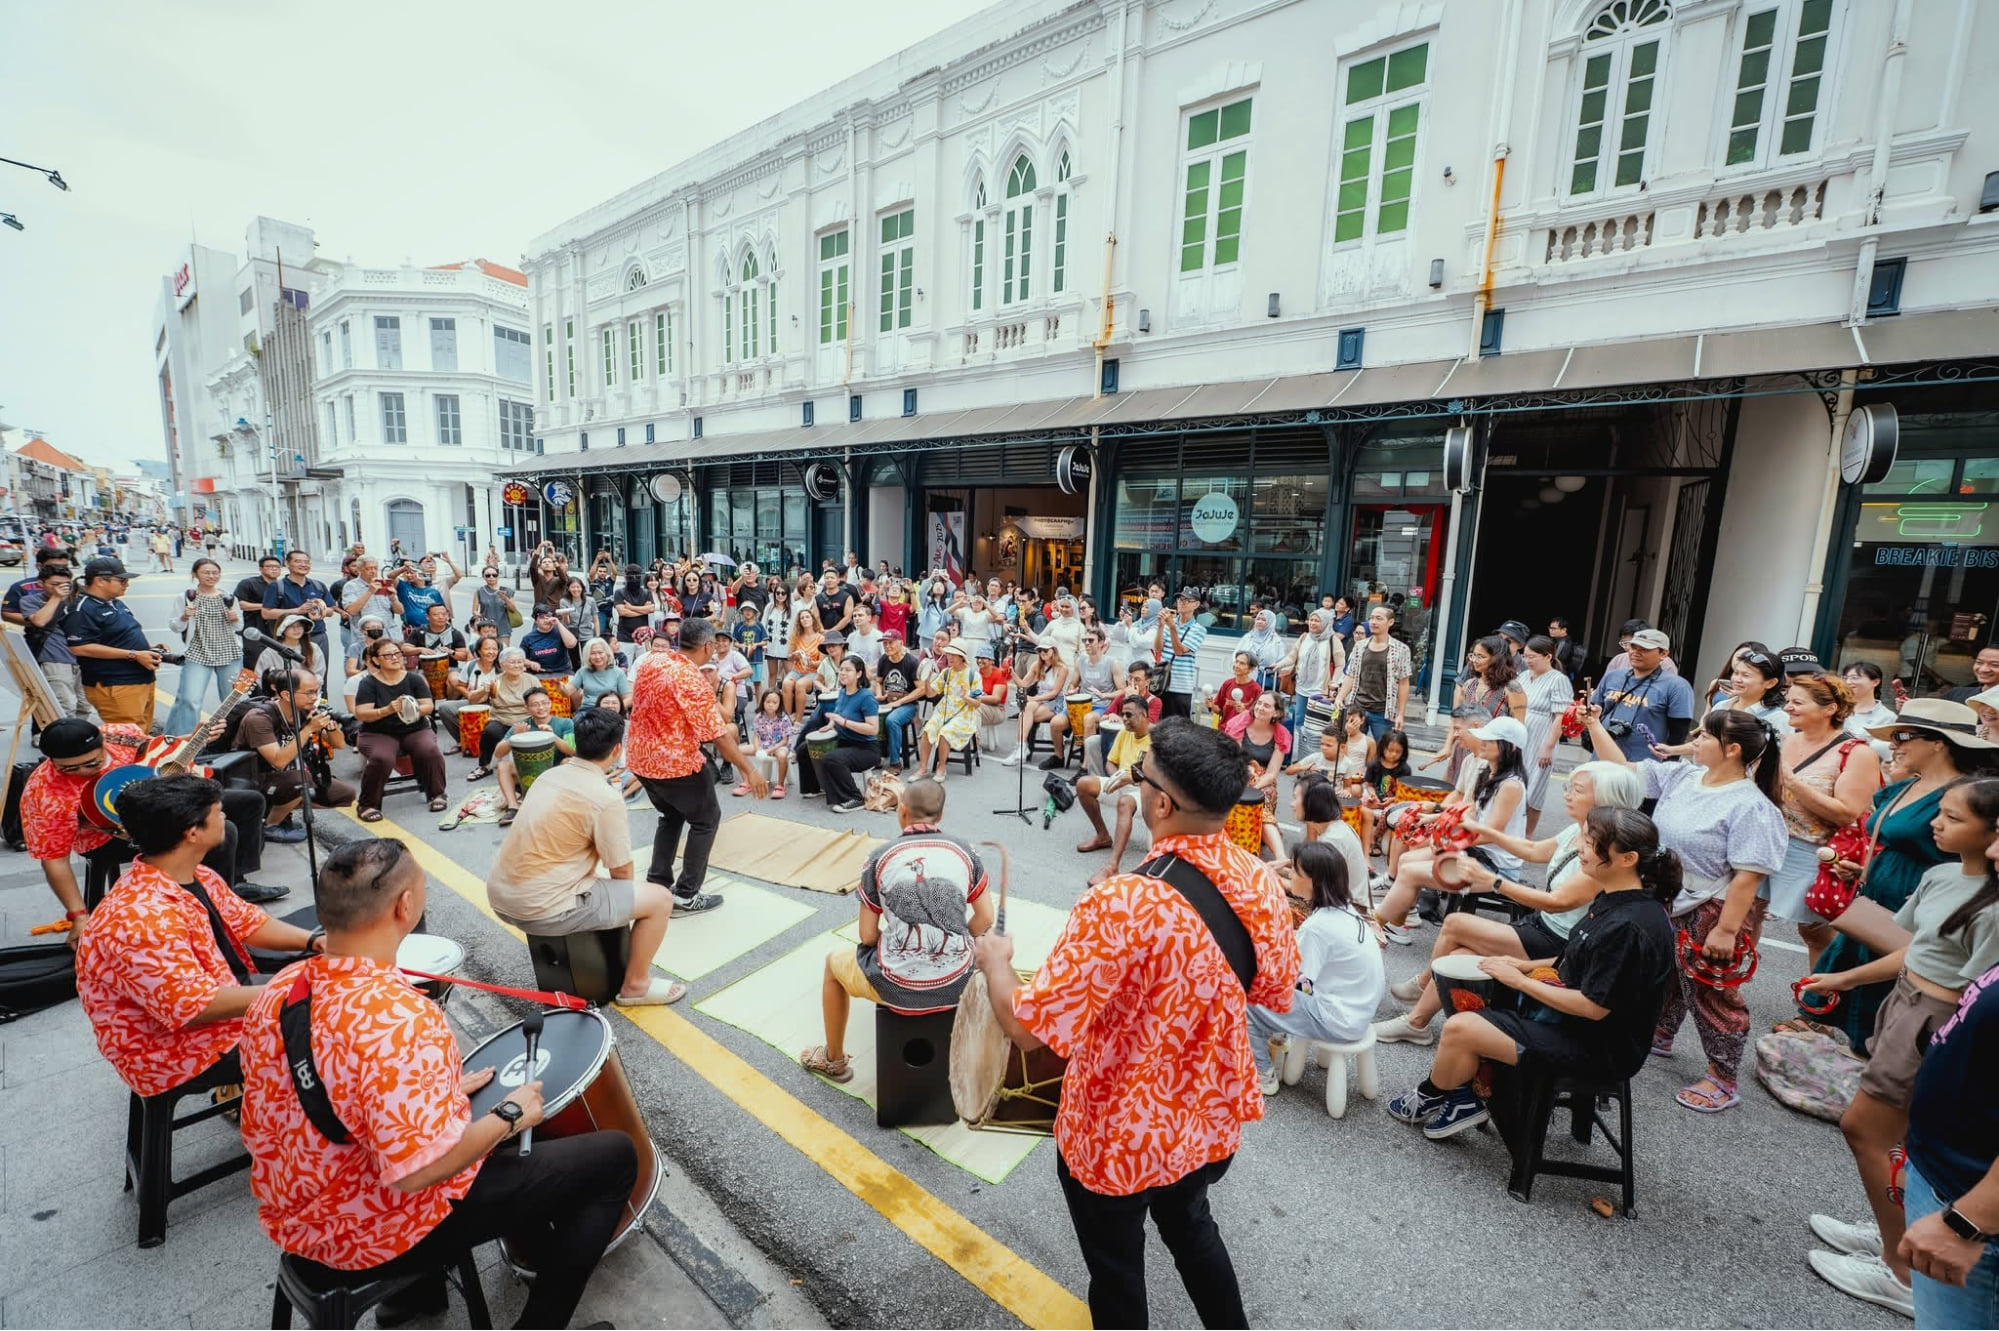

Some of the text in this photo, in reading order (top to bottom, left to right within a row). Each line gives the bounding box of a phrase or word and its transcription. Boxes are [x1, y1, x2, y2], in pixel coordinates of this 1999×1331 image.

[1195, 508, 1234, 520] JaJuJe
[1875, 547, 1960, 567] BREAKIE
[534, 647, 558, 656] umbro
